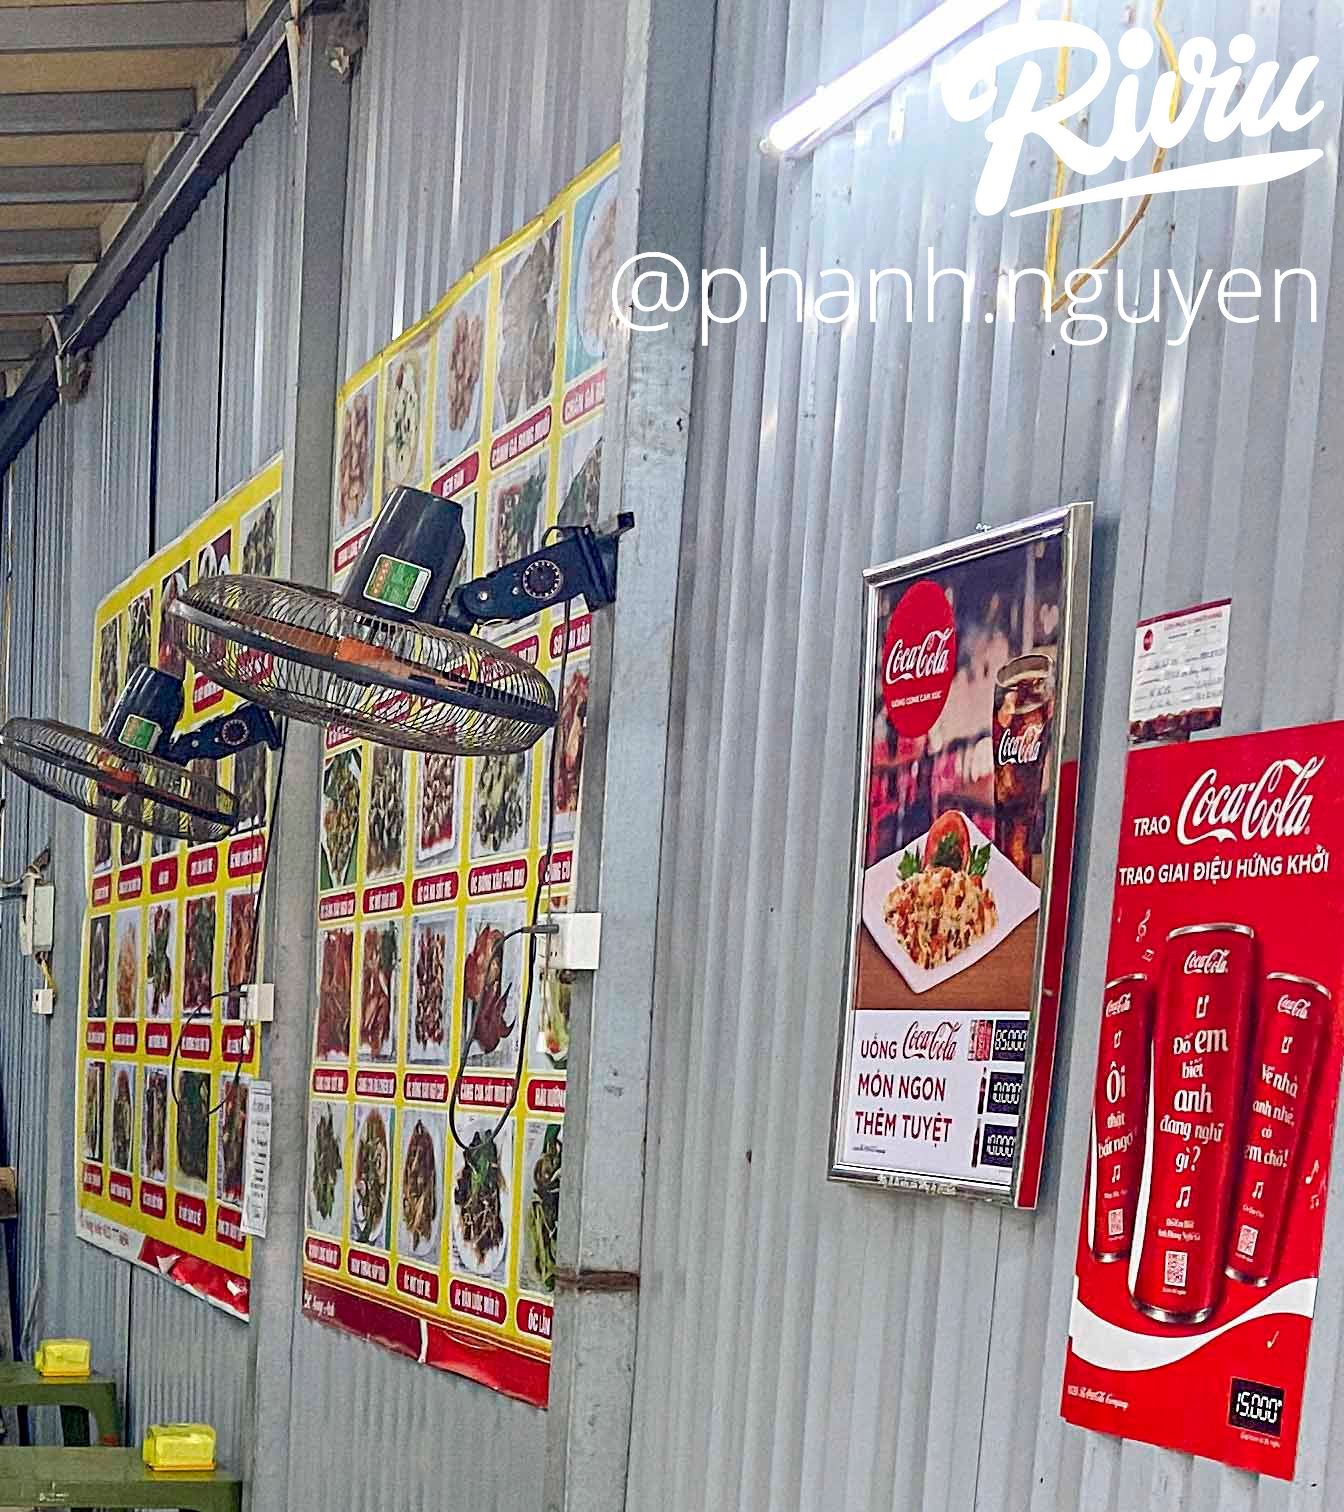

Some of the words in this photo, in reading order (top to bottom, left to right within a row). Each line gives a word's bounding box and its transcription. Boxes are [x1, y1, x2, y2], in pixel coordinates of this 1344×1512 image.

[1132, 815, 1171, 837] TRAO
[1118, 866, 1155, 886] TRAO
[1157, 863, 1189, 884] GIAI
[1192, 855, 1233, 885] ĐIỆU
[1235, 852, 1283, 876] HỨNG
[1194, 1027, 1229, 1054] em
[898, 1075, 947, 1102] NGON
[1173, 1083, 1213, 1113] anh
